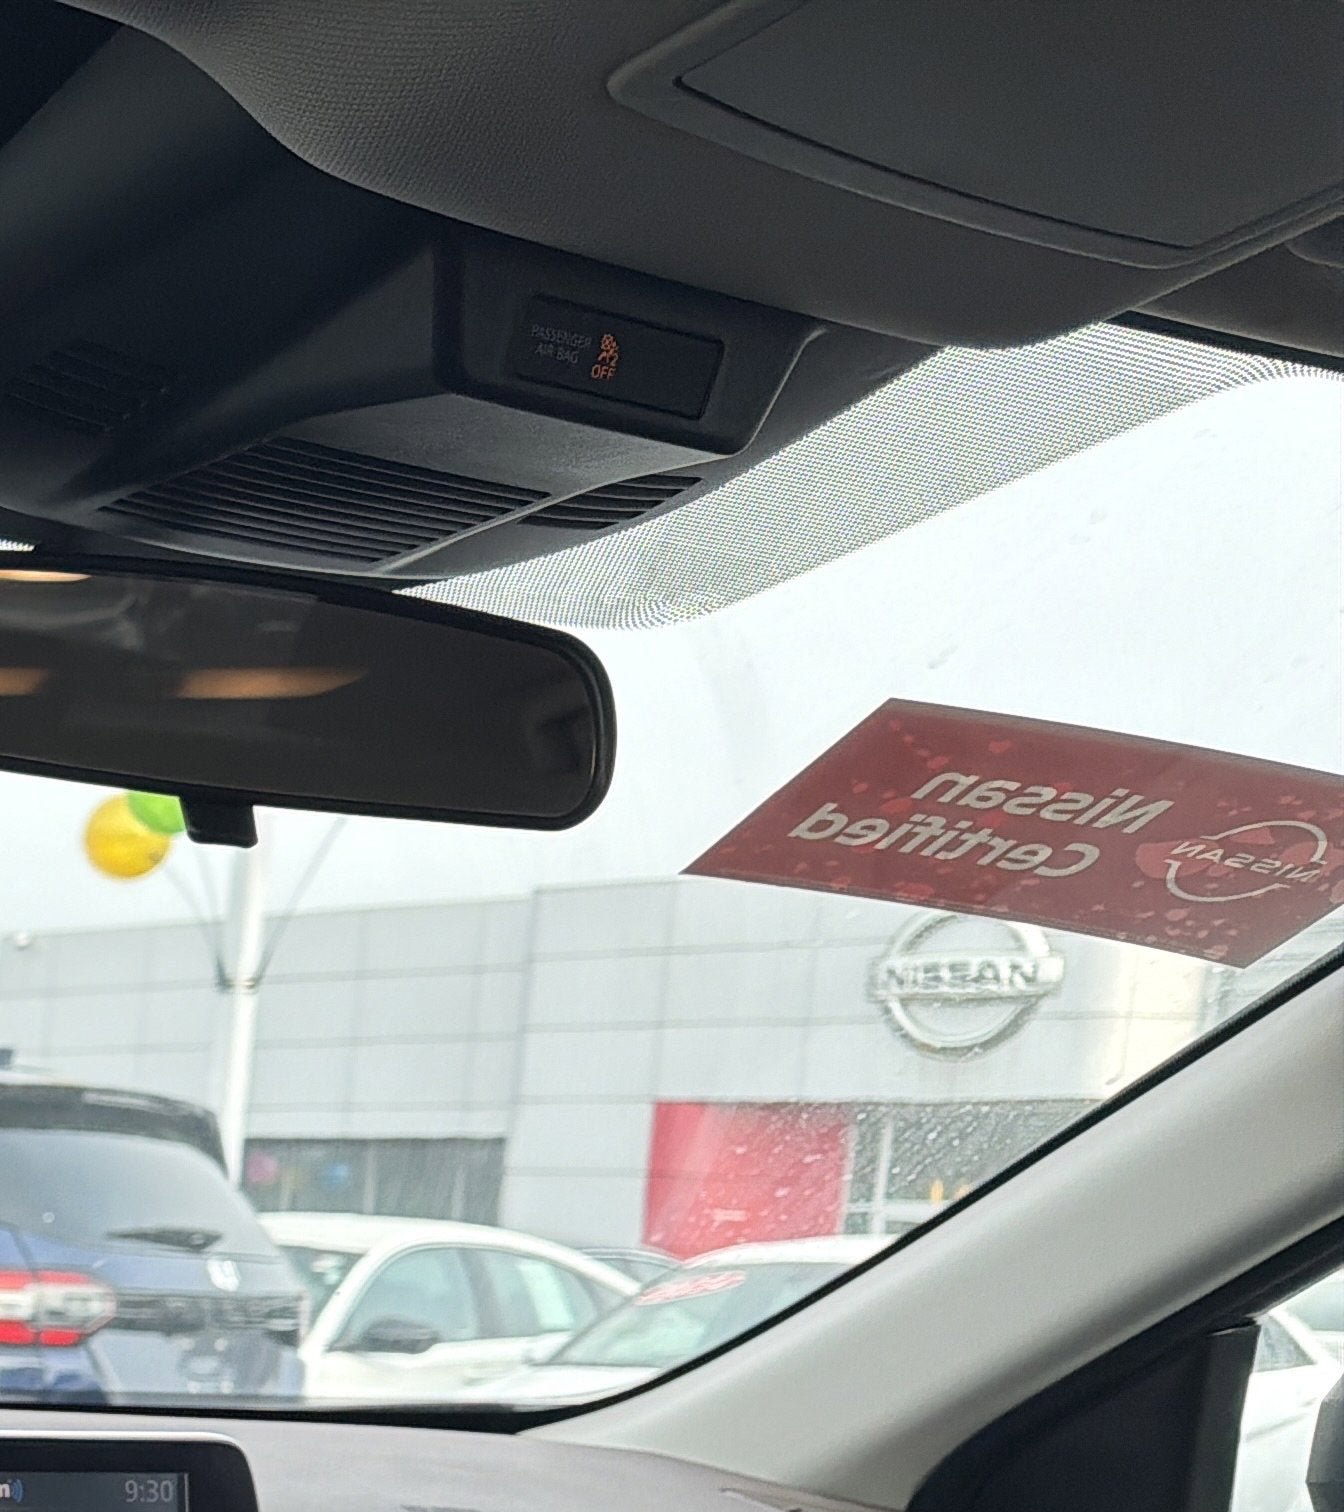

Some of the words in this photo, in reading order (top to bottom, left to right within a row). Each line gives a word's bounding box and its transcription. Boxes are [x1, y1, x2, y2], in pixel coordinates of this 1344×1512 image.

[591, 364, 616, 380] OFF
[878, 956, 1042, 994] NISSAN
[124, 1478, 174, 1503] 9:30
